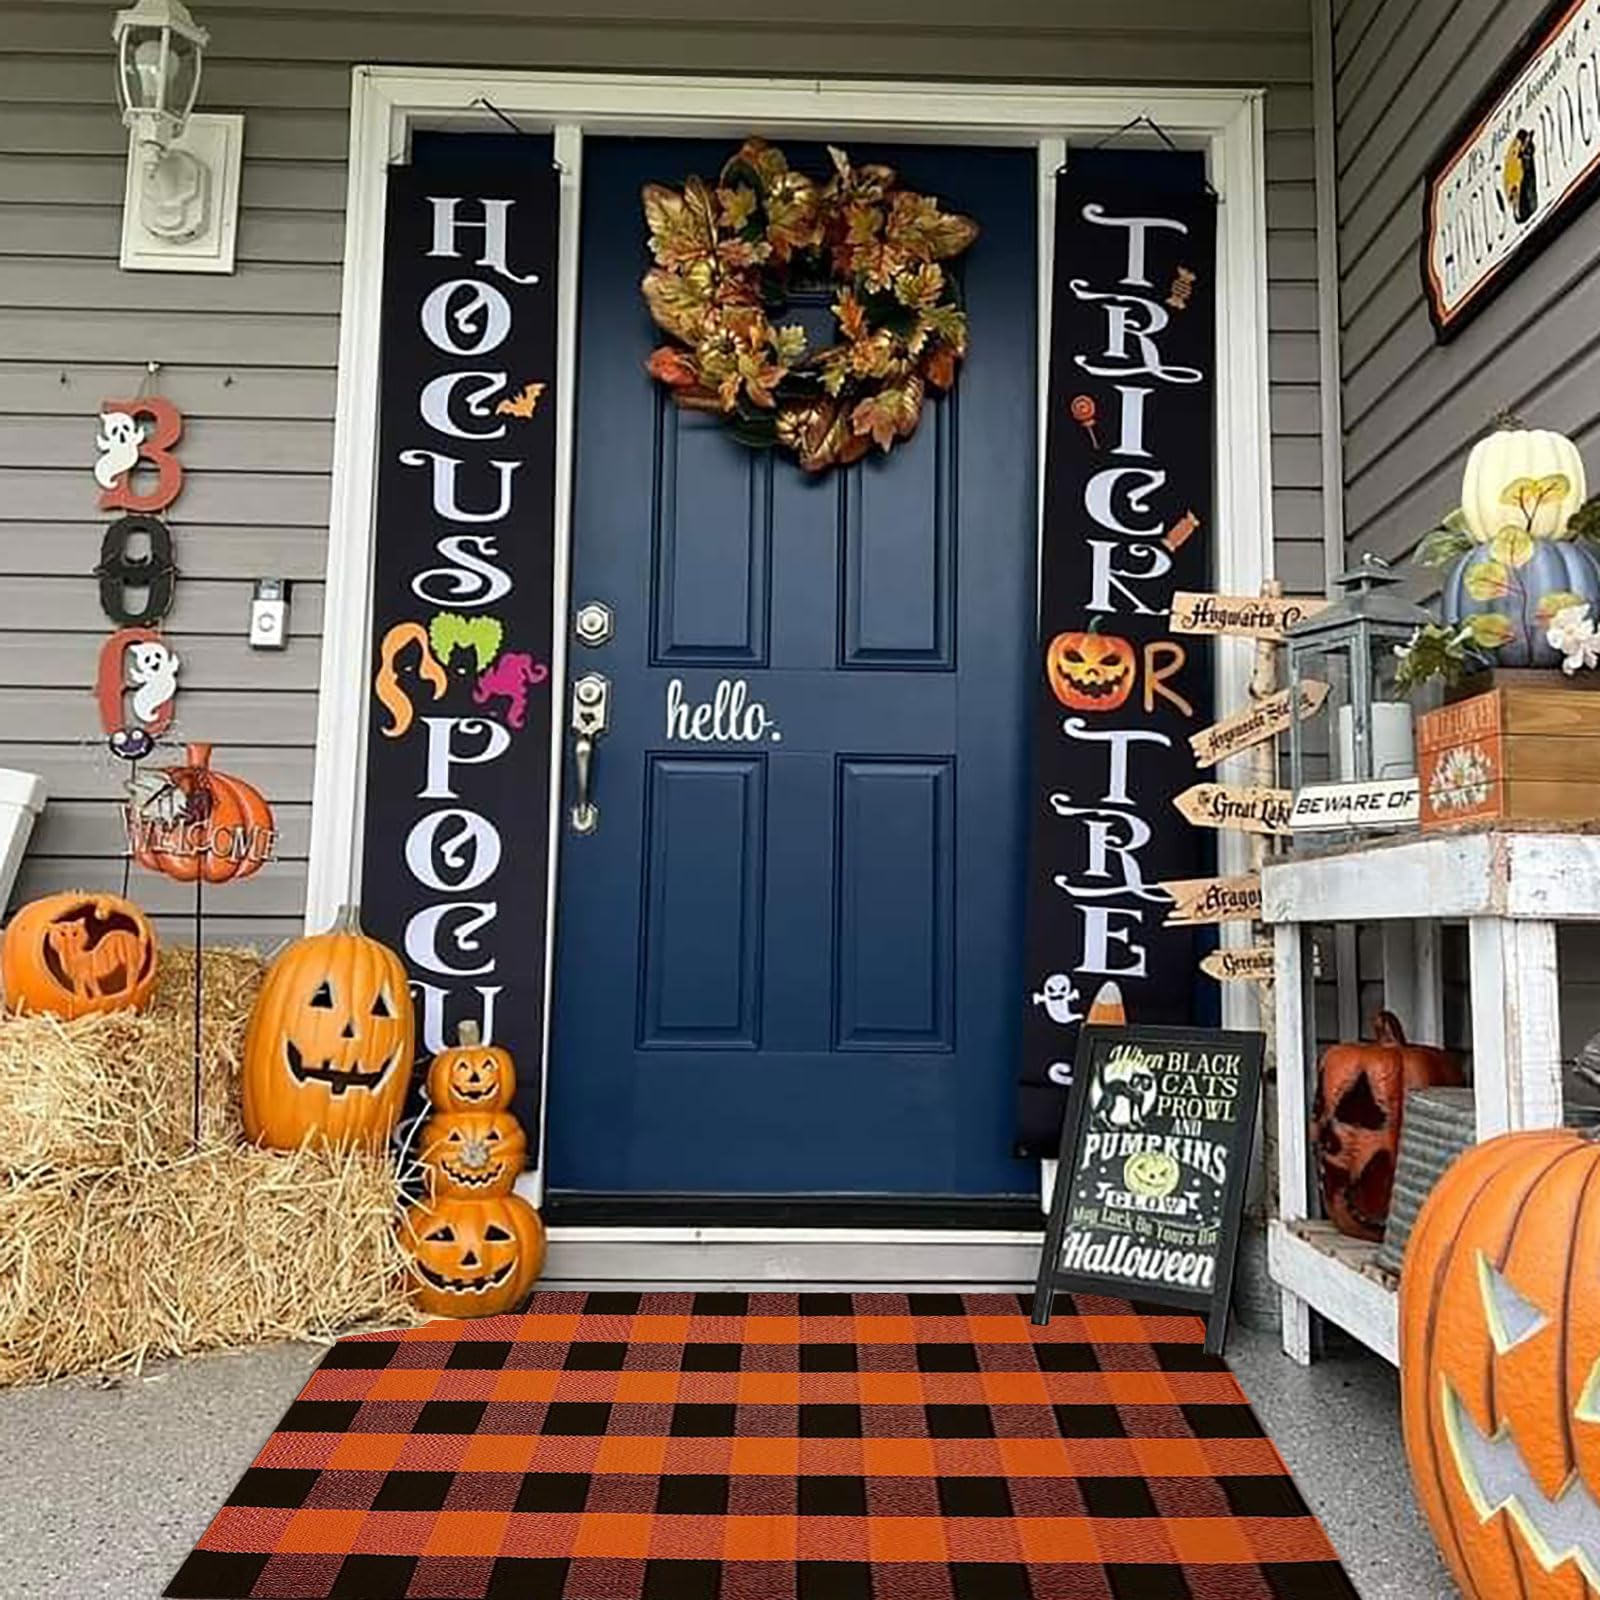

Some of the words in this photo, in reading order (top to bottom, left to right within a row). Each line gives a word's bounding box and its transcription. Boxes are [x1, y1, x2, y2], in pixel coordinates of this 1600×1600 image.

[399, 195, 539, 608] HOCUS
[1069, 203, 1203, 616] TRICK
[667, 679, 781, 741] hello.
[1208, 791, 1257, 823] Great
[1296, 793, 1384, 815] BEWARE
[1387, 790, 1419, 808] OF
[121, 804, 283, 863] WELCOME
[404, 716, 512, 1056] POCU
[1050, 717, 1174, 1025] TRE
[1161, 1074, 1239, 1098] CATS
[1167, 1051, 1241, 1075] BLACK
[1156, 1095, 1236, 1121] PROWL
[1171, 1118, 1202, 1136] AND
[1080, 1132, 1227, 1184] PUMPKINS
[1062, 1231, 1216, 1288] Halloween
